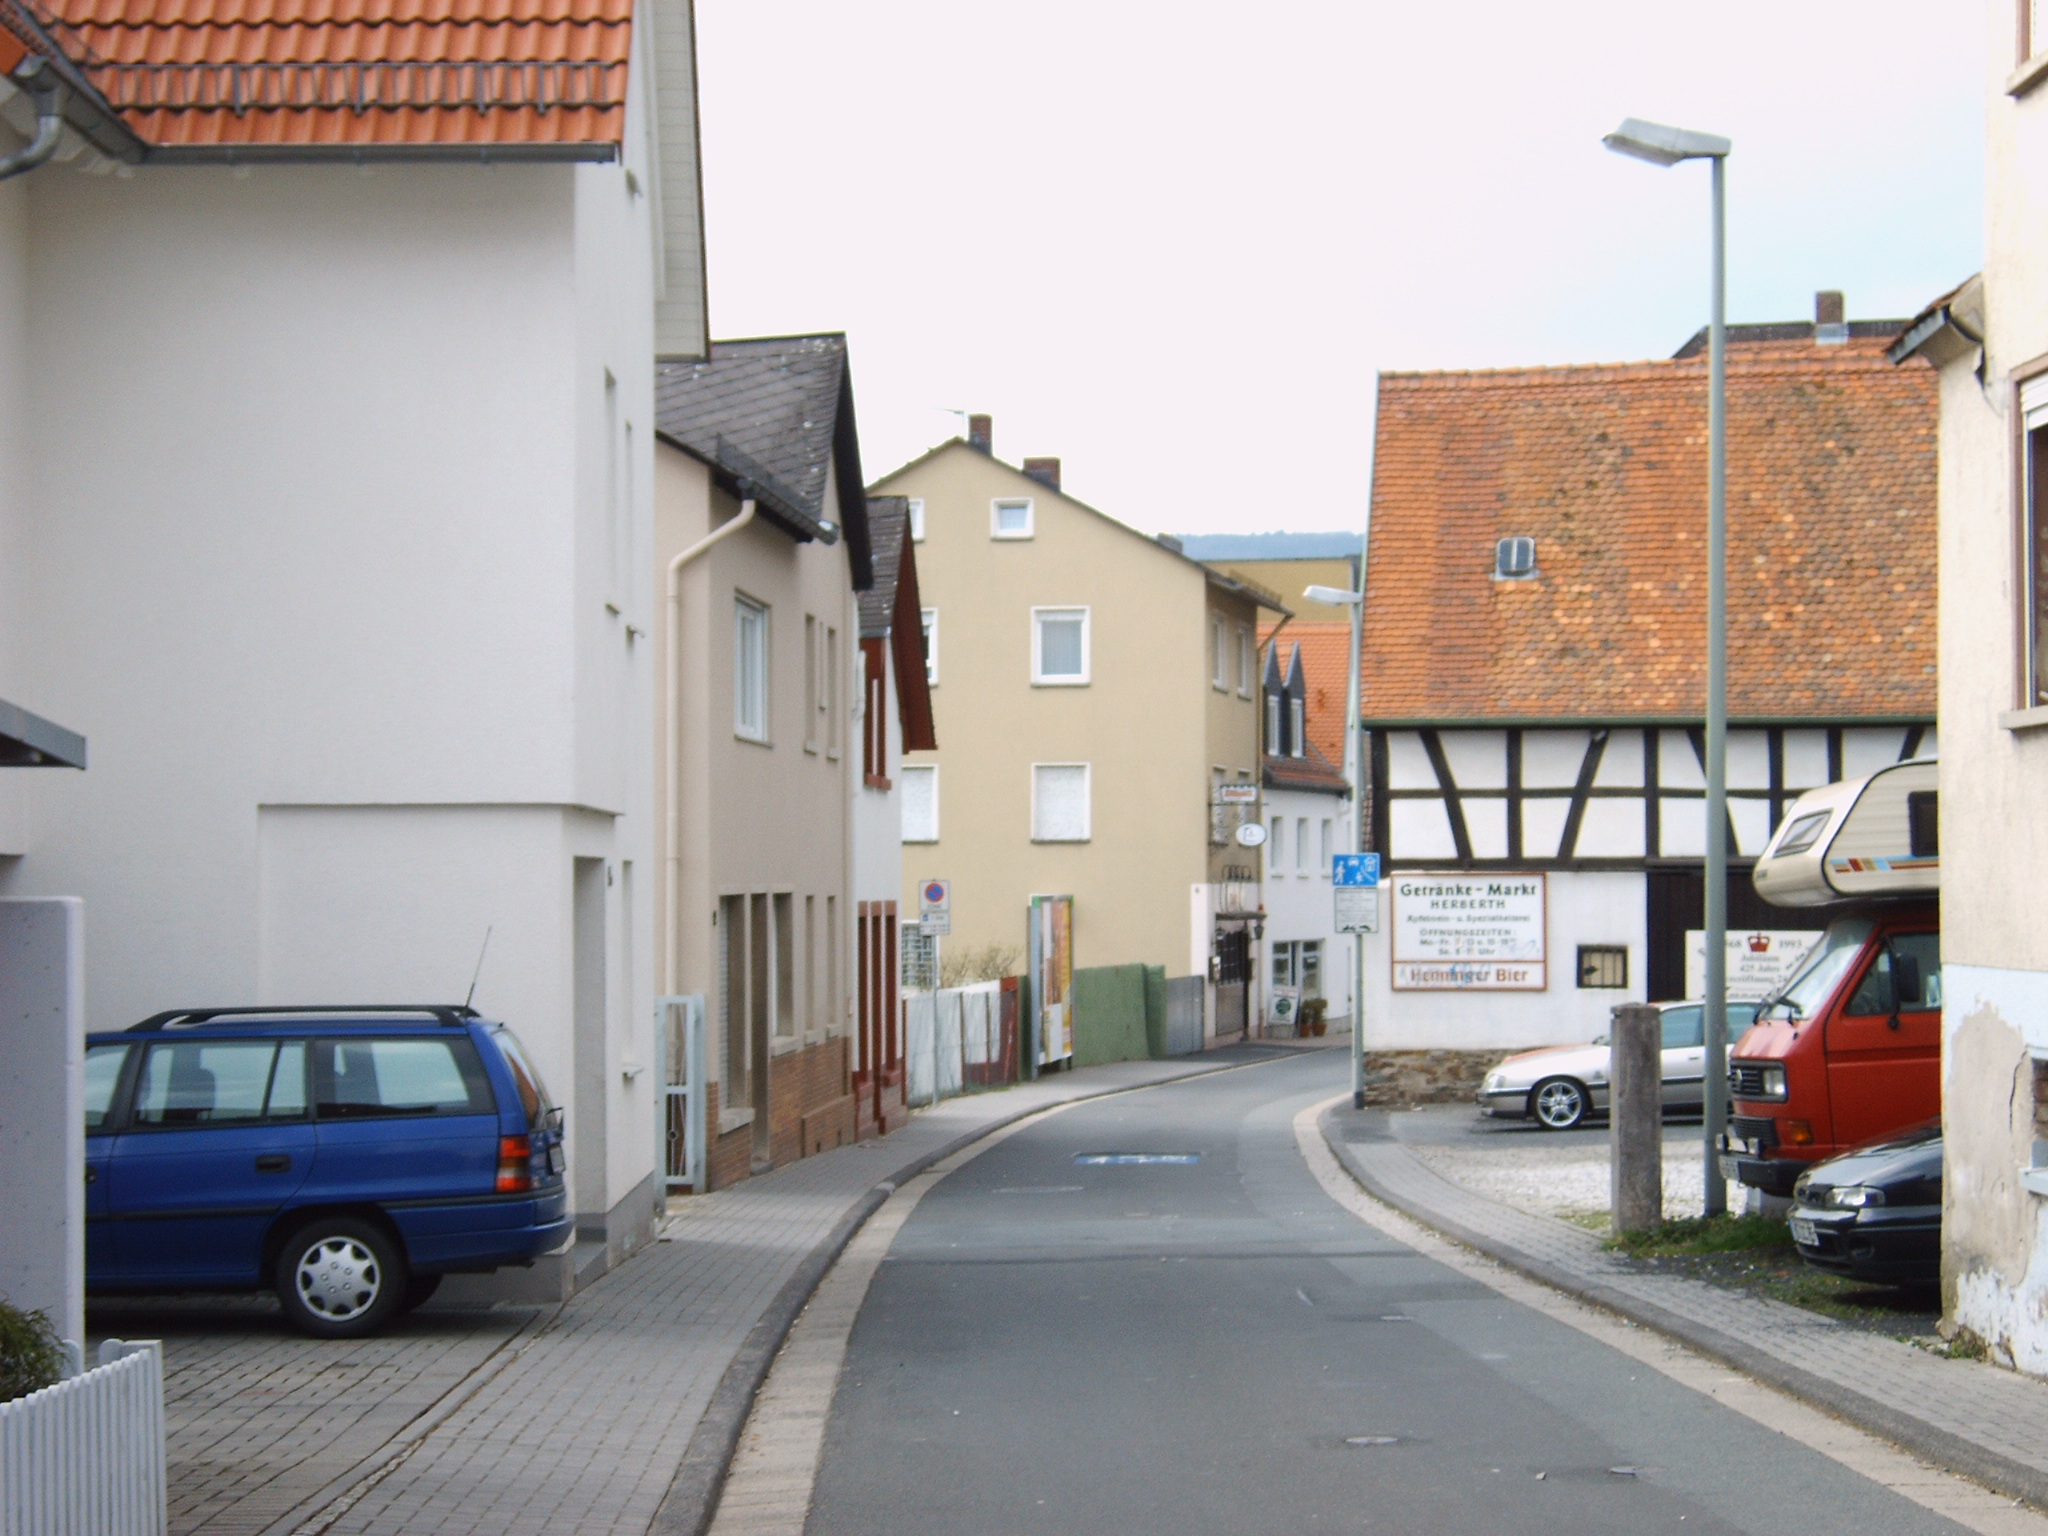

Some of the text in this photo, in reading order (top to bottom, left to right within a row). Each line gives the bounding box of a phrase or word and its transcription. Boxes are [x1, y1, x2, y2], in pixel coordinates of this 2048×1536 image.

[1488, 883, 1537, 896] Markt
[1430, 900, 1506, 909] HERBERTH
[1496, 968, 1529, 982] Bier
